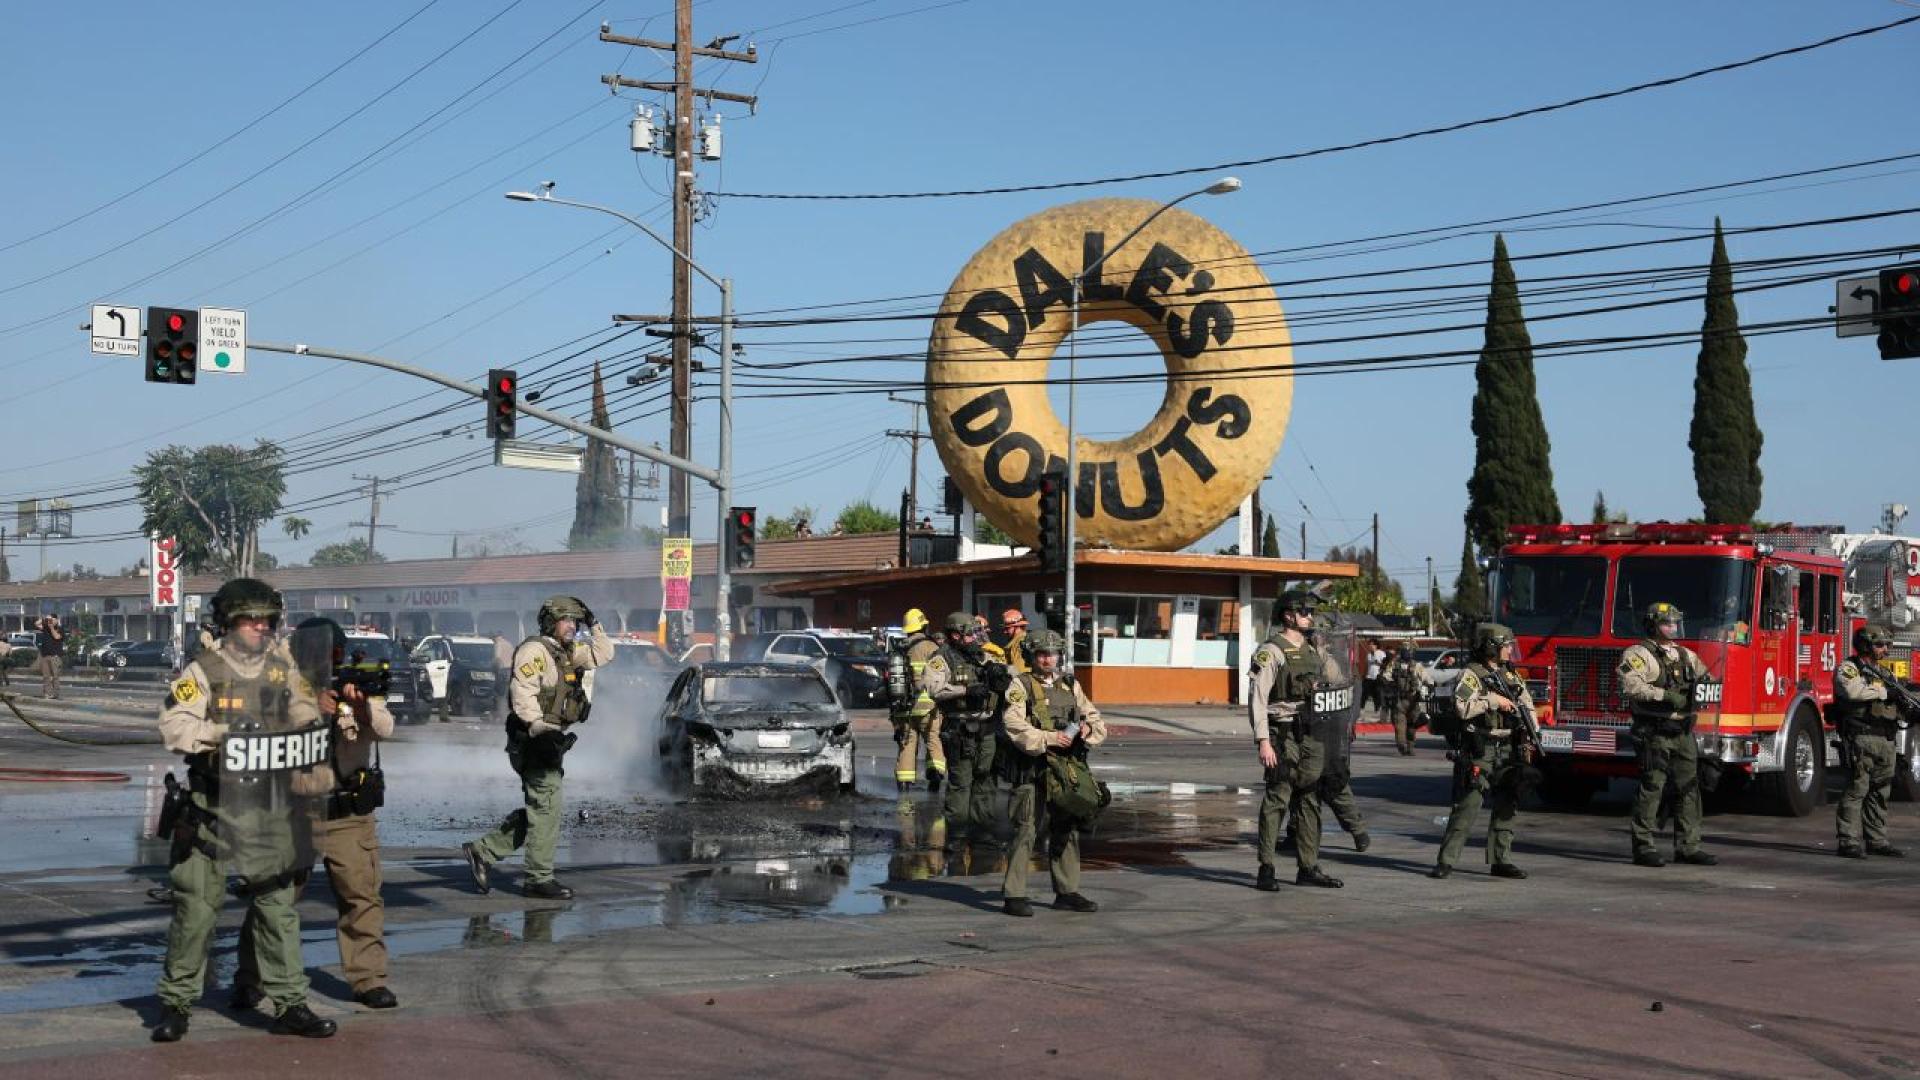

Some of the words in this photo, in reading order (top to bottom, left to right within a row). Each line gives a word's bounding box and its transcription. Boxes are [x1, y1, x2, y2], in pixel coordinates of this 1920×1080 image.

[955, 231, 1235, 360] DALE'S
[205, 316, 222, 325] LEFT
[210, 327, 236, 338] YIELD
[94, 341, 104, 349] NO
[107, 340, 115, 351] U
[118, 343, 137, 351] TURN
[218, 340, 240, 348] GREEN
[1821, 641, 1836, 671] 45
[226, 728, 330, 772] SHERIFF
